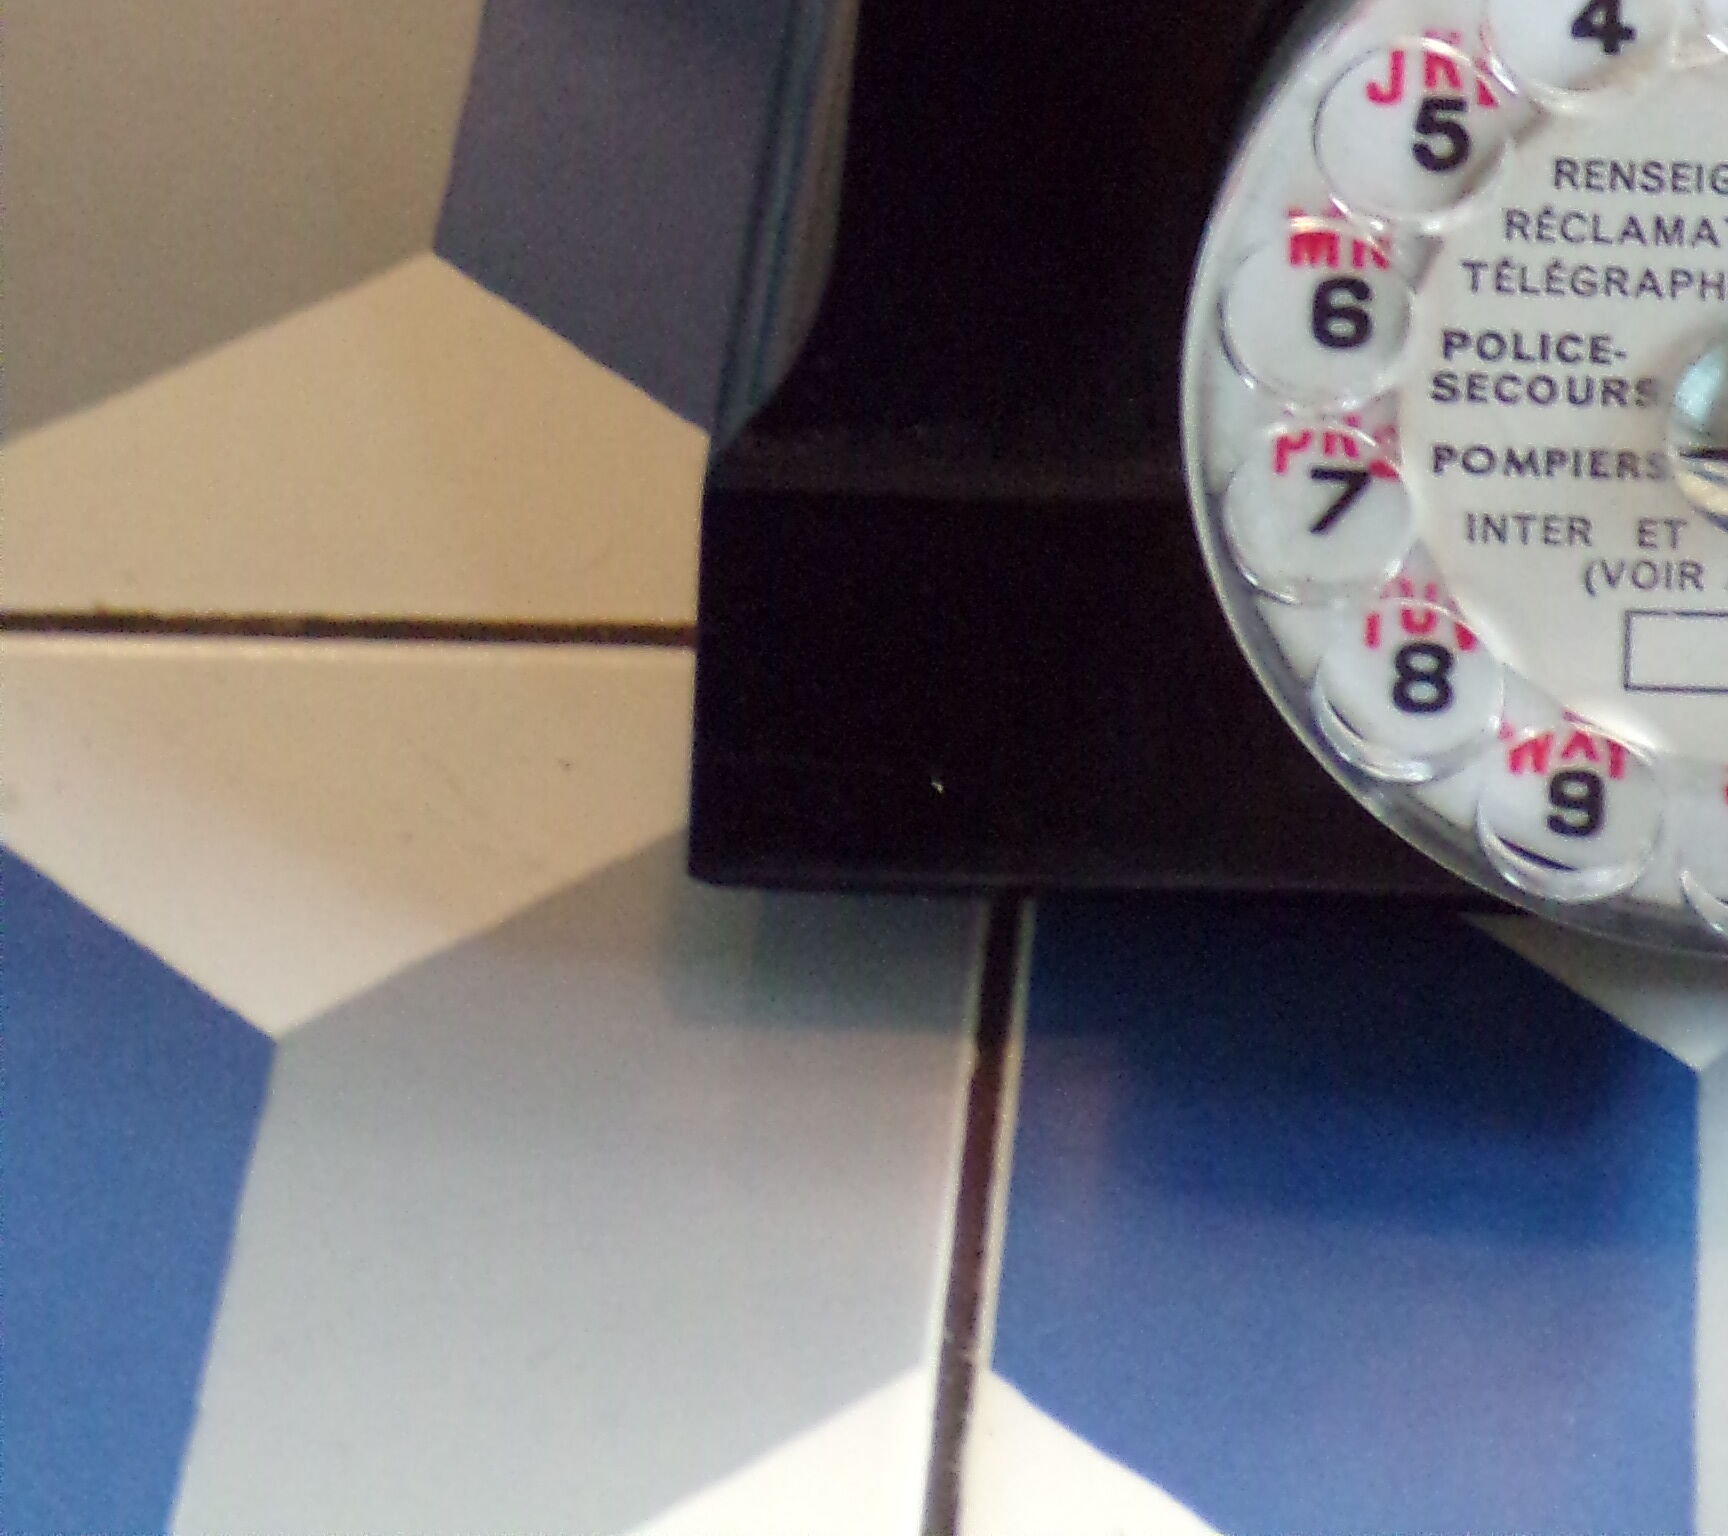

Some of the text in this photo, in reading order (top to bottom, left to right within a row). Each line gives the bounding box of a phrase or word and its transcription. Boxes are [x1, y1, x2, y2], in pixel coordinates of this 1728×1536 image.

[1412, 97, 1471, 172] 5
[1312, 277, 1373, 349] 6
[1442, 328, 1628, 366] POLICE-
[1430, 372, 1658, 408] SECOURS
[1431, 444, 1668, 481] POMPIERS
[1309, 466, 1372, 536] 7
[1465, 511, 1594, 548] INTER
[1637, 516, 1689, 551] ET
[1583, 558, 1706, 598] (VOIR
[1391, 641, 1455, 714] 8
[1545, 768, 1604, 837] 9
